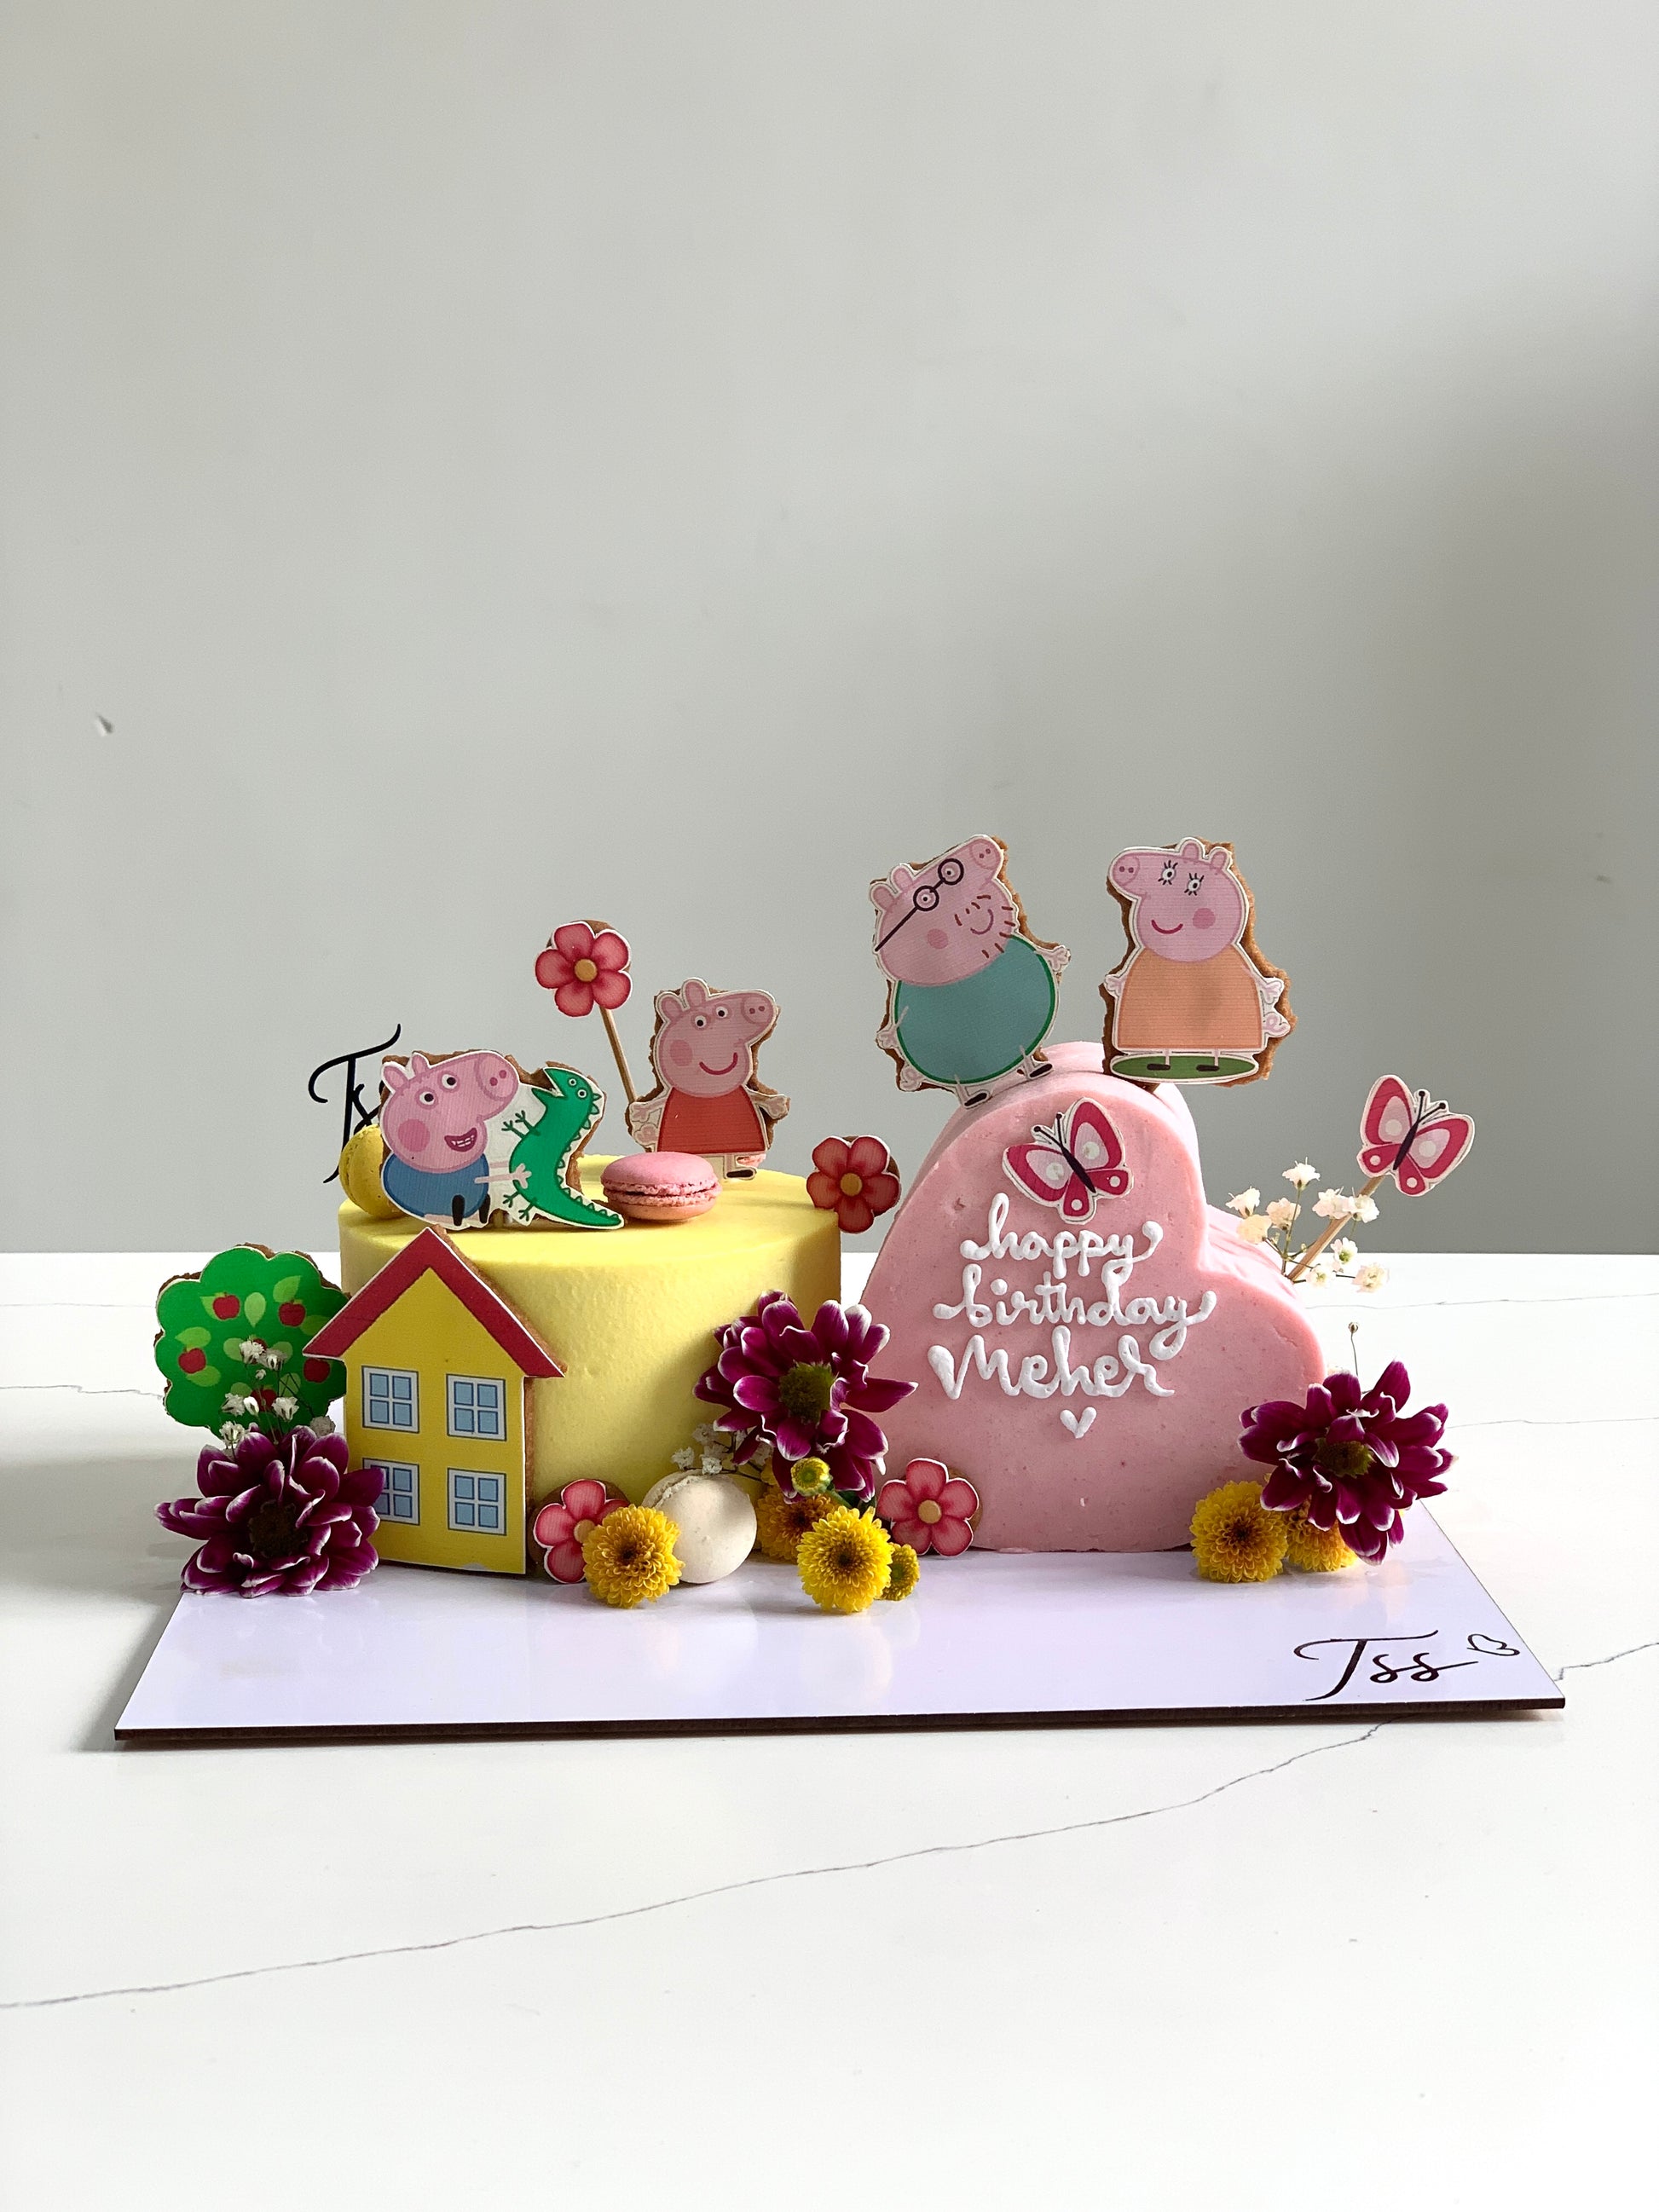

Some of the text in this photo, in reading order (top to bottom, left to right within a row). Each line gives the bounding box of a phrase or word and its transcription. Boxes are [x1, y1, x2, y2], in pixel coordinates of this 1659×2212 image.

[960, 1193, 1164, 1287] happy
[933, 1263, 1217, 1361] birthday
[928, 1325, 1176, 1400] Meher
[1293, 1629, 1479, 1701] Tss
